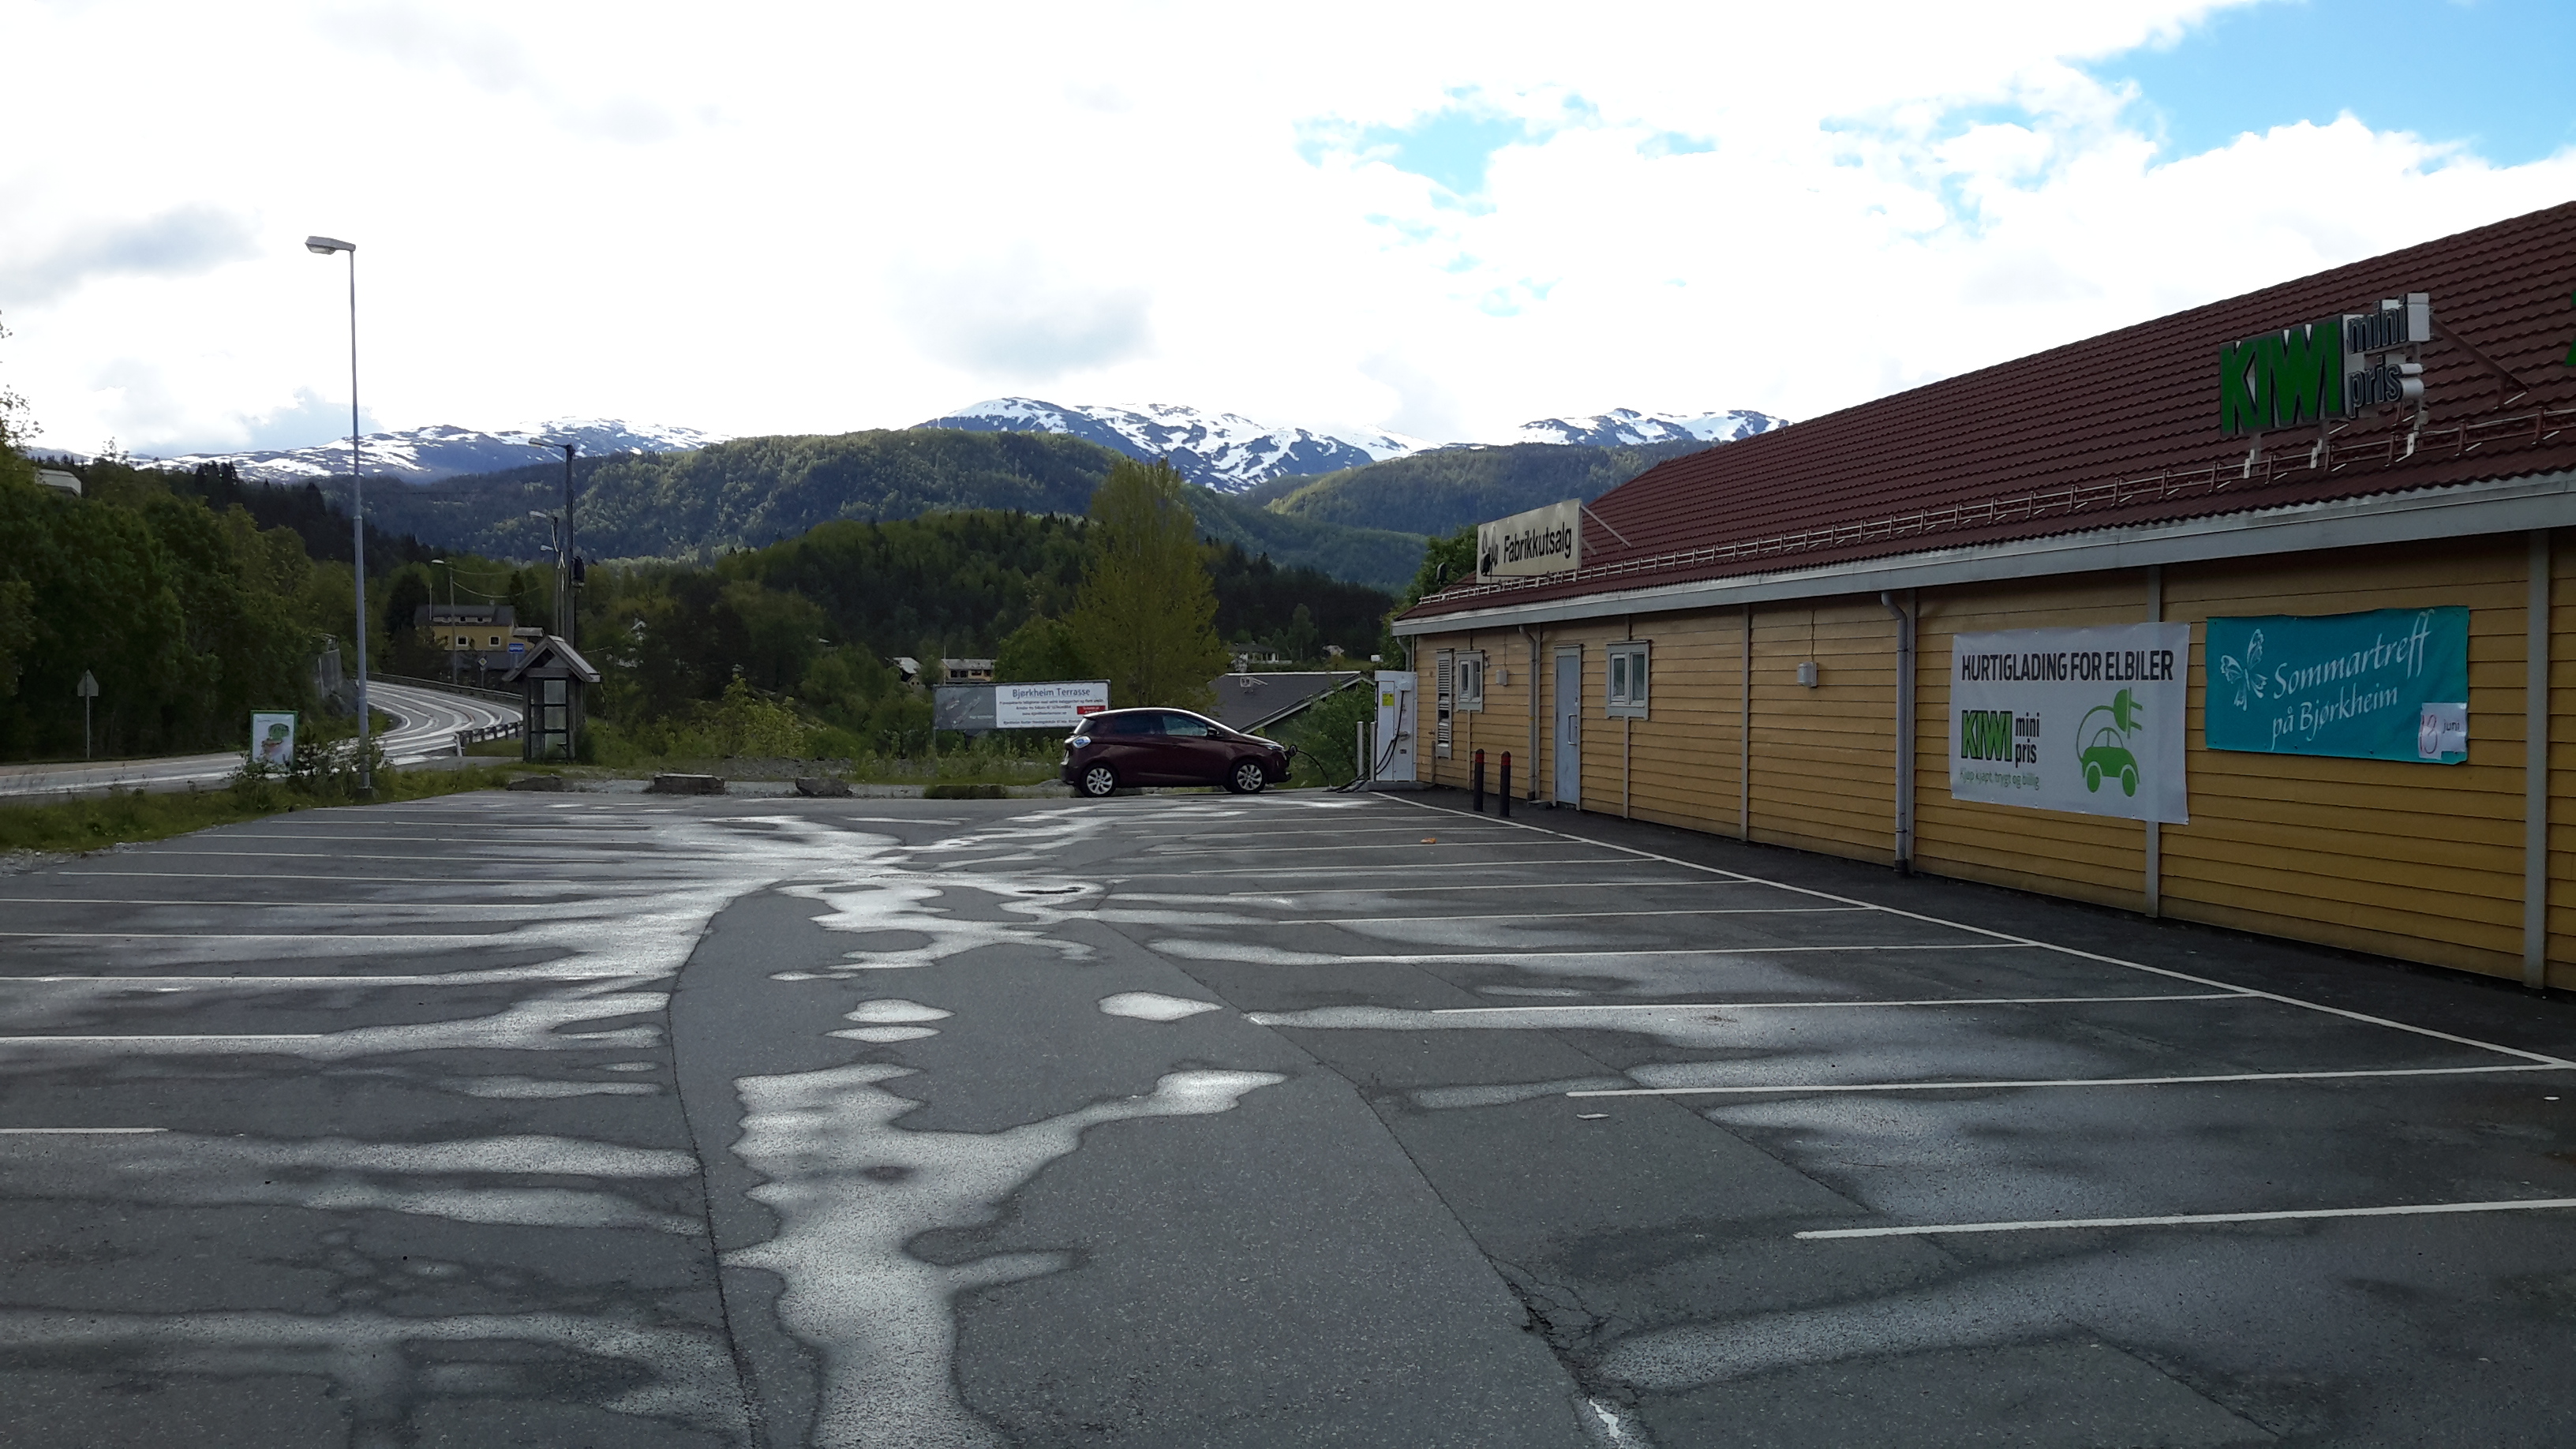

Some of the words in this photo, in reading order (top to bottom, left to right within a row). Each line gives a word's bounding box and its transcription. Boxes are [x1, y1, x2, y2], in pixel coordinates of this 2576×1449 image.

[2347, 294, 2406, 354] mini
[2218, 315, 2346, 436] KIWI
[2346, 354, 2403, 419] pris
[1503, 522, 1572, 564] Fabrikkutsalg
[1961, 653, 2067, 680] HURTIGLADING
[2070, 652, 2102, 680] FOR
[2105, 650, 2174, 680] ELBILER
[2272, 608, 2435, 699] Sommartreff
[1013, 688, 1054, 699] Bjørkheim
[1057, 687, 1090, 696] Terrasse
[1961, 710, 2012, 762] KIWI
[2015, 712, 2039, 737] mini
[2271, 706, 2294, 751] på
[2299, 683, 2398, 742] Bjørkheim
[2443, 719, 2460, 734] juni
[2015, 738, 2037, 768] pris
